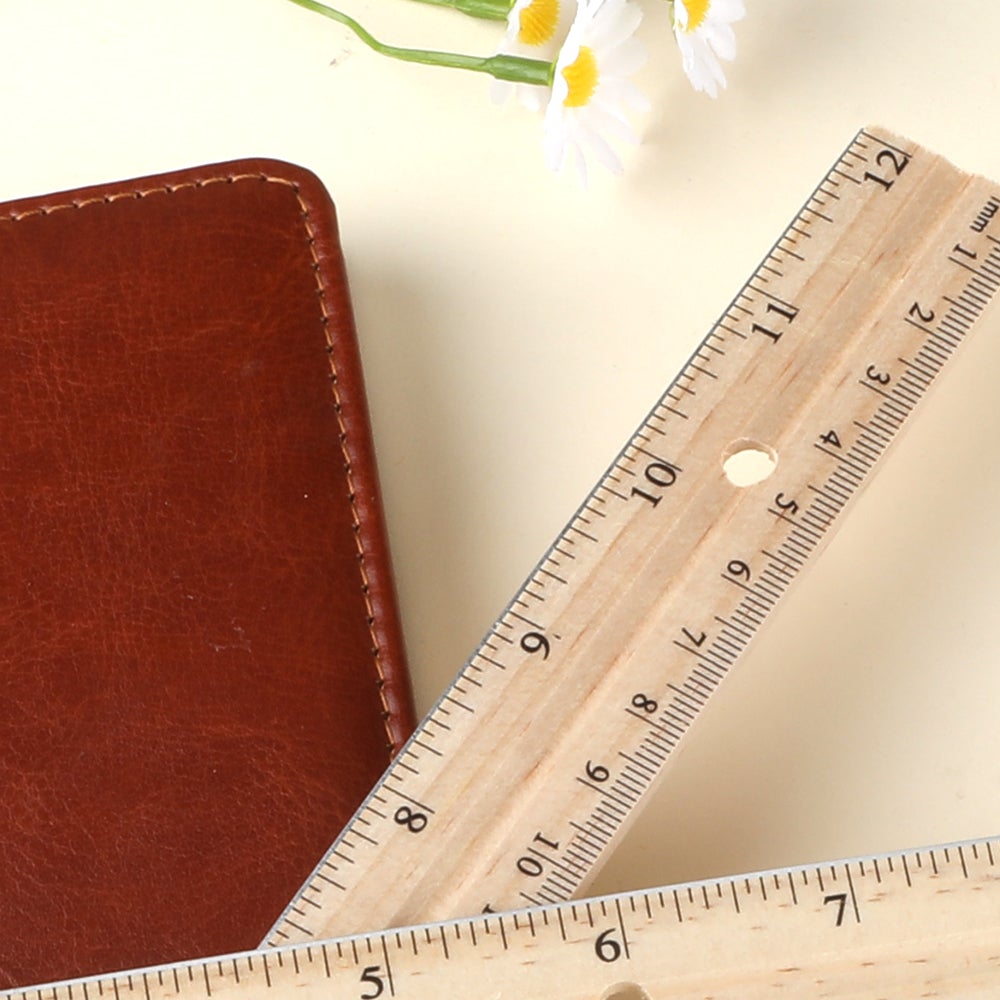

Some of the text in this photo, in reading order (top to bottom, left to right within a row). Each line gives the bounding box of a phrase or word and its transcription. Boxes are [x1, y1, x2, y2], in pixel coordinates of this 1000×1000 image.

[394, 150, 909, 833] 8 9 10 11 12
[517, 200, 1000, 878] mm 1 2 3 4 5 6 7 8 9 10
[361, 966, 384, 999] 5
[595, 928, 620, 962] 6
[823, 893, 847, 926] 7
